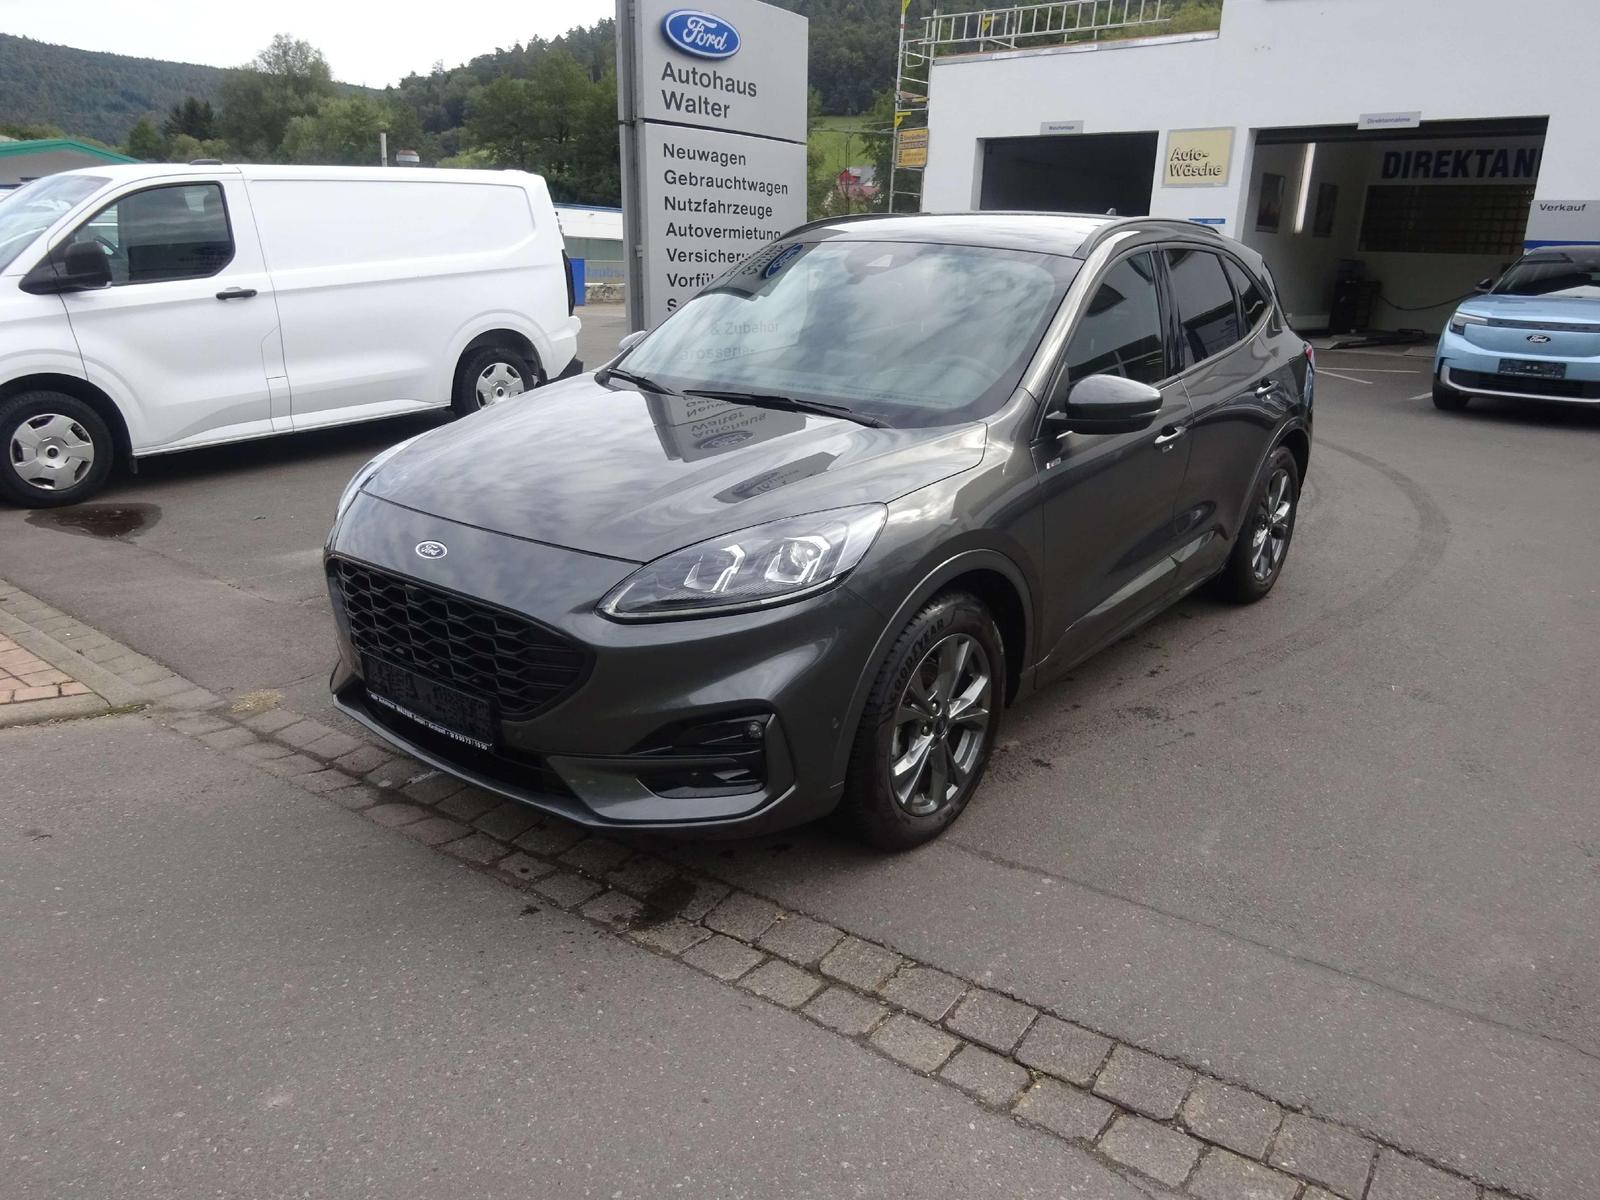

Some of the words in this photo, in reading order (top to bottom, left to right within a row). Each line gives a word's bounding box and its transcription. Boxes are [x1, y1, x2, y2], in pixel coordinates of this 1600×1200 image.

[682, 16, 728, 50] Ford
[661, 61, 757, 97] Autohaus
[661, 89, 730, 119] Walter
[663, 143, 746, 167] Neuwagen
[1170, 146, 1210, 162] Auto-
[1169, 161, 1222, 177] Wäsche
[664, 169, 788, 196] Gebrauchtwagen
[664, 196, 773, 219] Nutzfahrzeuge
[1539, 203, 1587, 212] Verkauf
[665, 222, 782, 241] Autovermietung
[666, 248, 751, 263] Versicher
[667, 273, 715, 288] Vorfü
